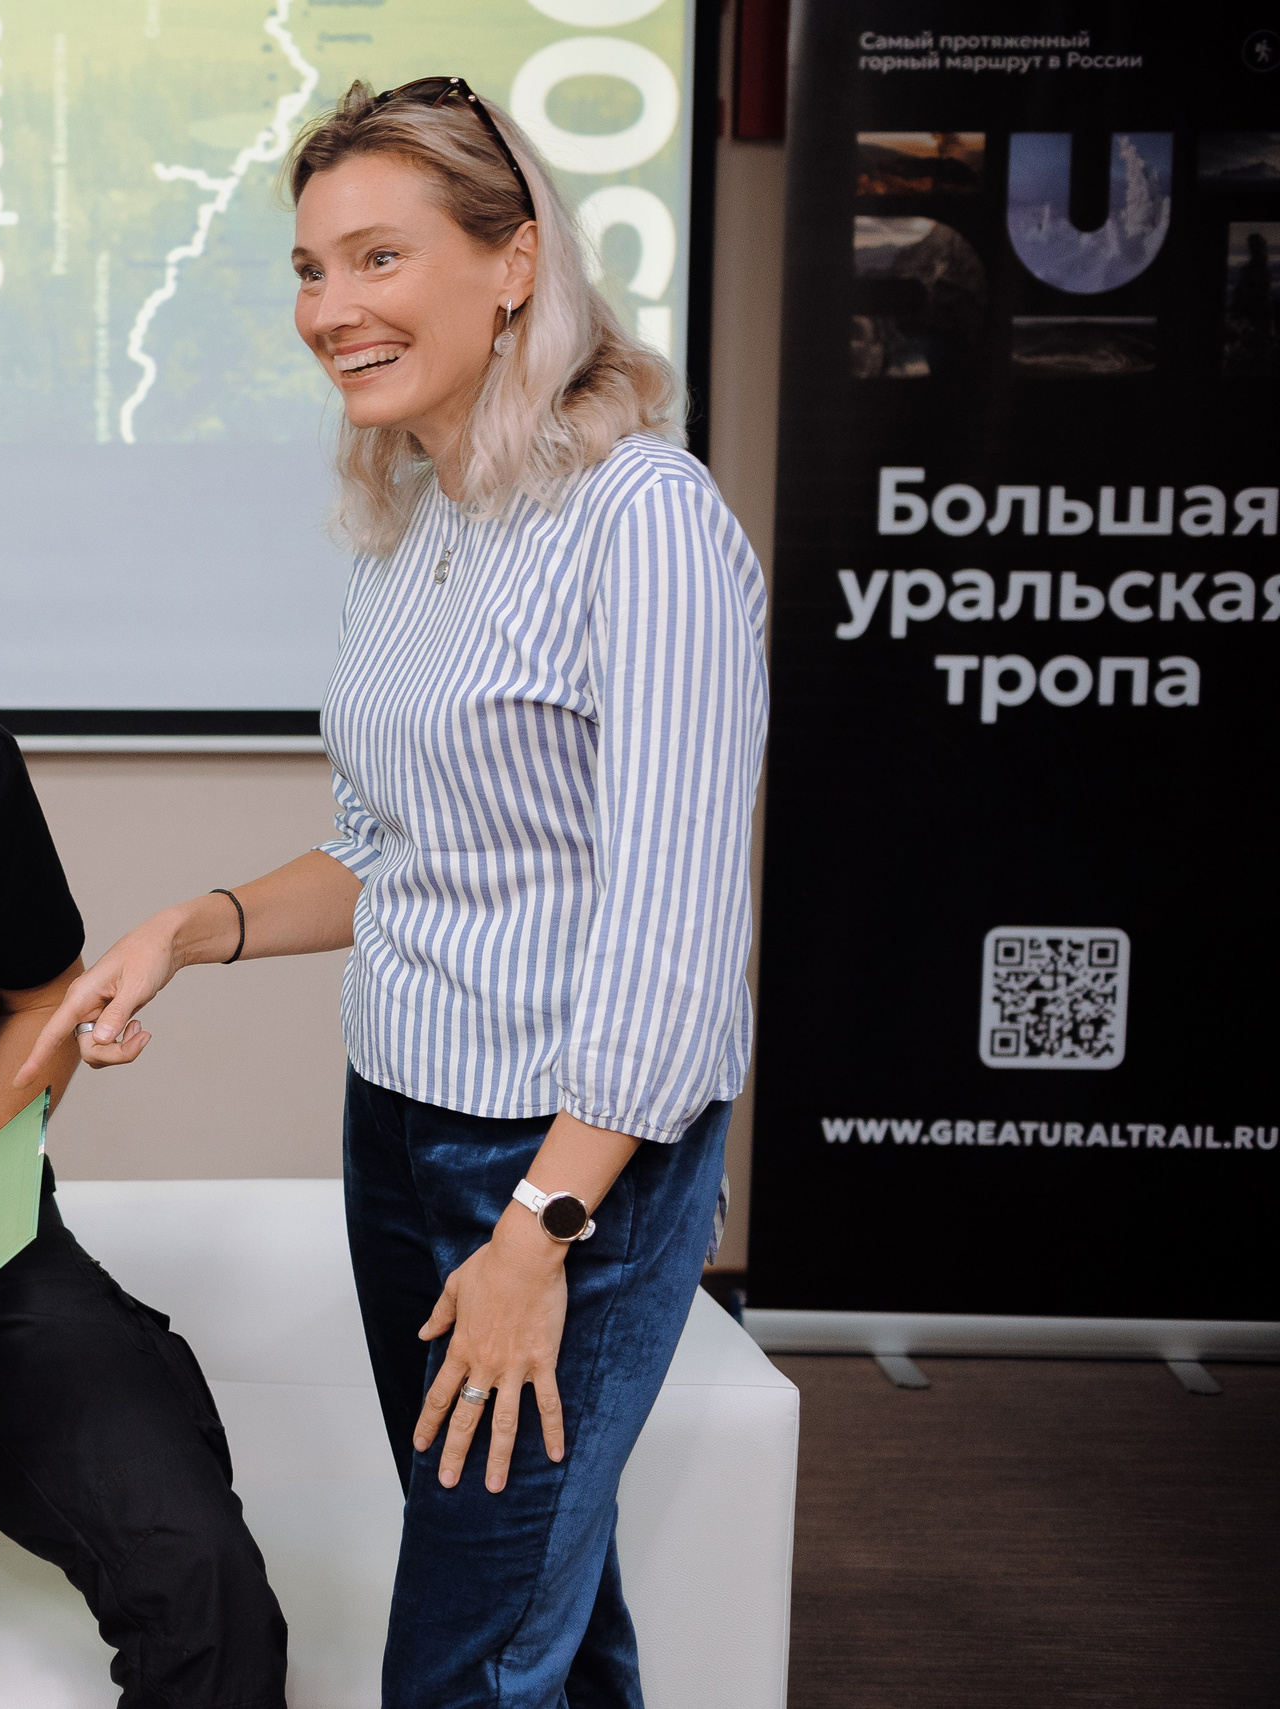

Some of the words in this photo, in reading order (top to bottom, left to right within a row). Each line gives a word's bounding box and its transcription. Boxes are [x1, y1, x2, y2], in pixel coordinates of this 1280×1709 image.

[859, 30, 933, 51] Самый
[939, 30, 1091, 53] протяженный
[859, 53, 940, 74] горный
[946, 54, 1042, 73] маршрут
[1049, 54, 1061, 69] в
[1067, 53, 1143, 70] России
[877, 466, 1280, 537] Большая
[934, 654, 1201, 724] тропа
[822, 1117, 1279, 1150] WWW.GREATURALTRAIL.RU
